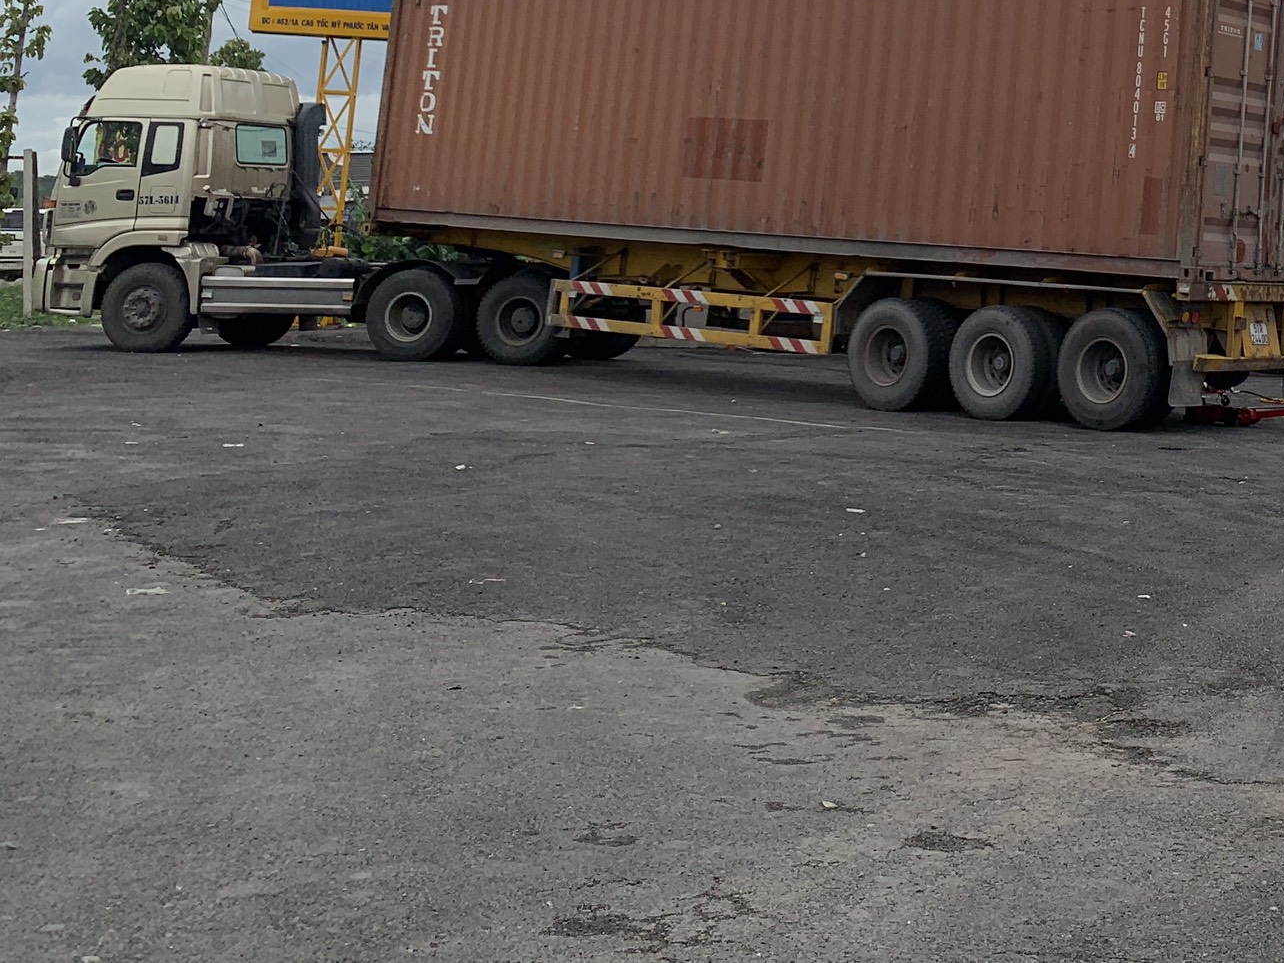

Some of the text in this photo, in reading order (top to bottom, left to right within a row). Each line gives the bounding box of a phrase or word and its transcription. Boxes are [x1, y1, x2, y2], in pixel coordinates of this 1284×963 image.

[1137, 6, 1147, 58] TCNU
[1162, 6, 1171, 58] 45G1
[415, 4, 449, 135] TRITON
[1130, 61, 1143, 141] 804013
